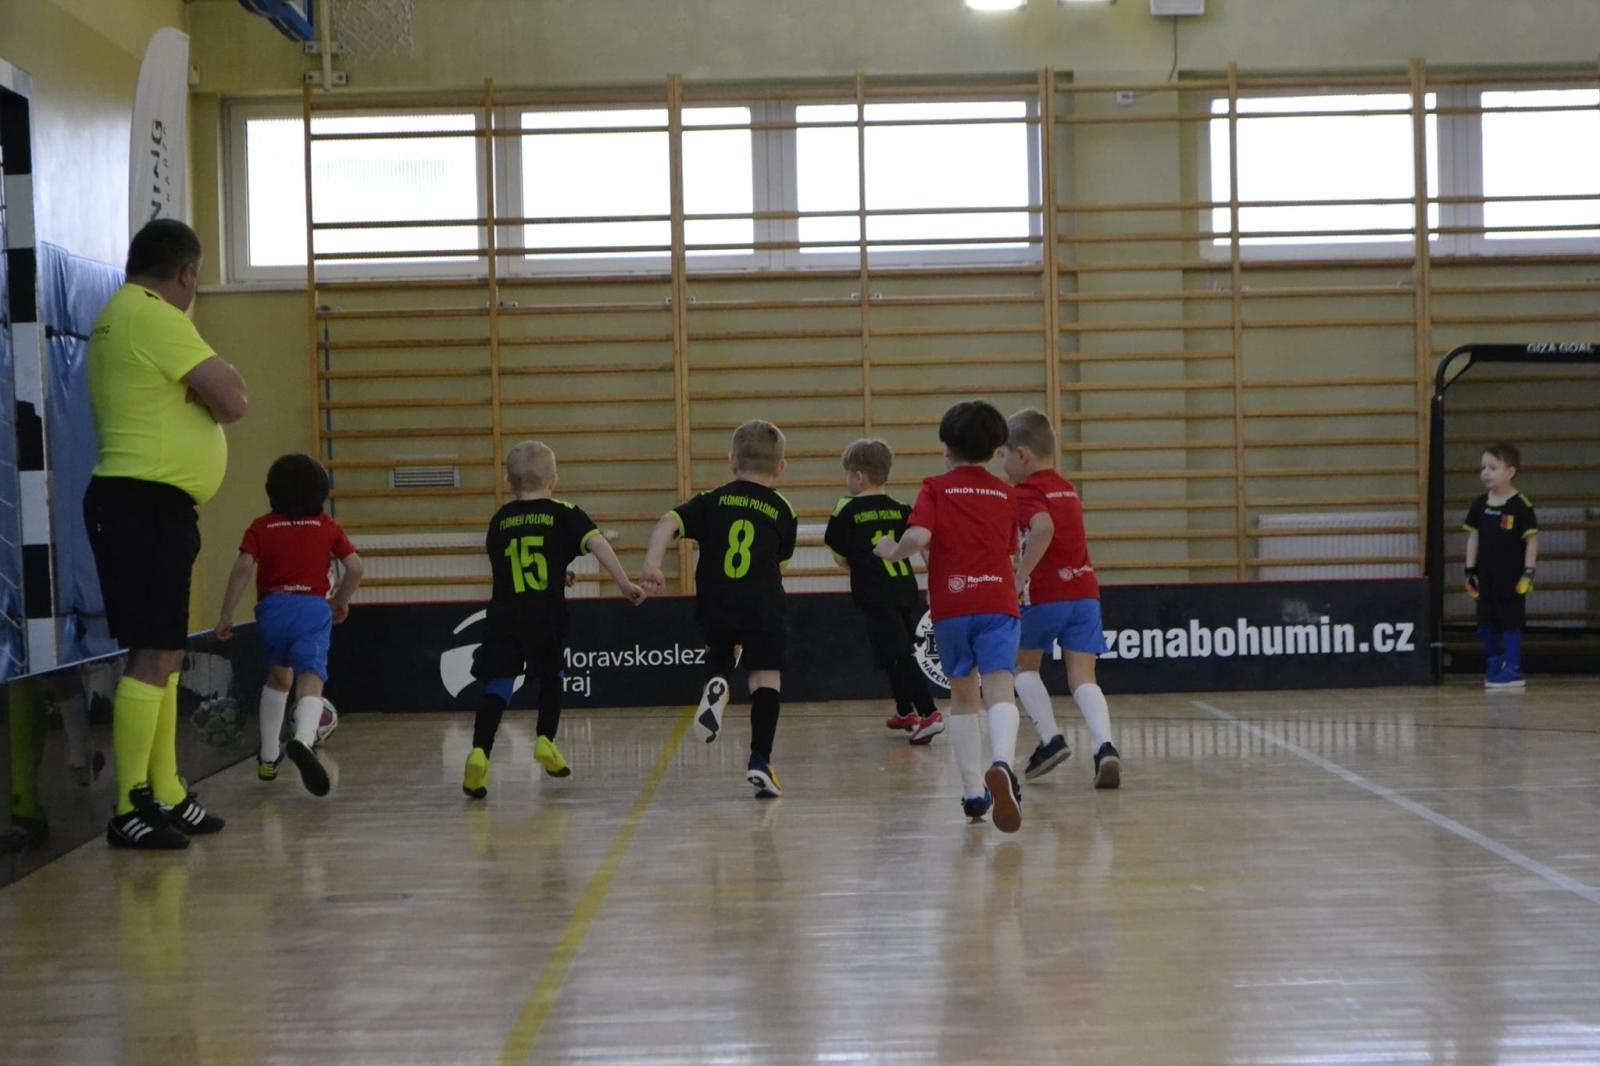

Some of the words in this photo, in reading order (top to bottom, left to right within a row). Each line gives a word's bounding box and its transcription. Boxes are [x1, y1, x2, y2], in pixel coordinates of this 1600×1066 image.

[1526, 342, 1557, 353] GIZA
[1559, 342, 1595, 353] GOAL
[945, 487, 974, 495] JUNIOR
[504, 535, 549, 593] 15
[723, 519, 755, 579] 8
[1052, 615, 1415, 660] zenabohumin.cz
[563, 670, 592, 698] raj
